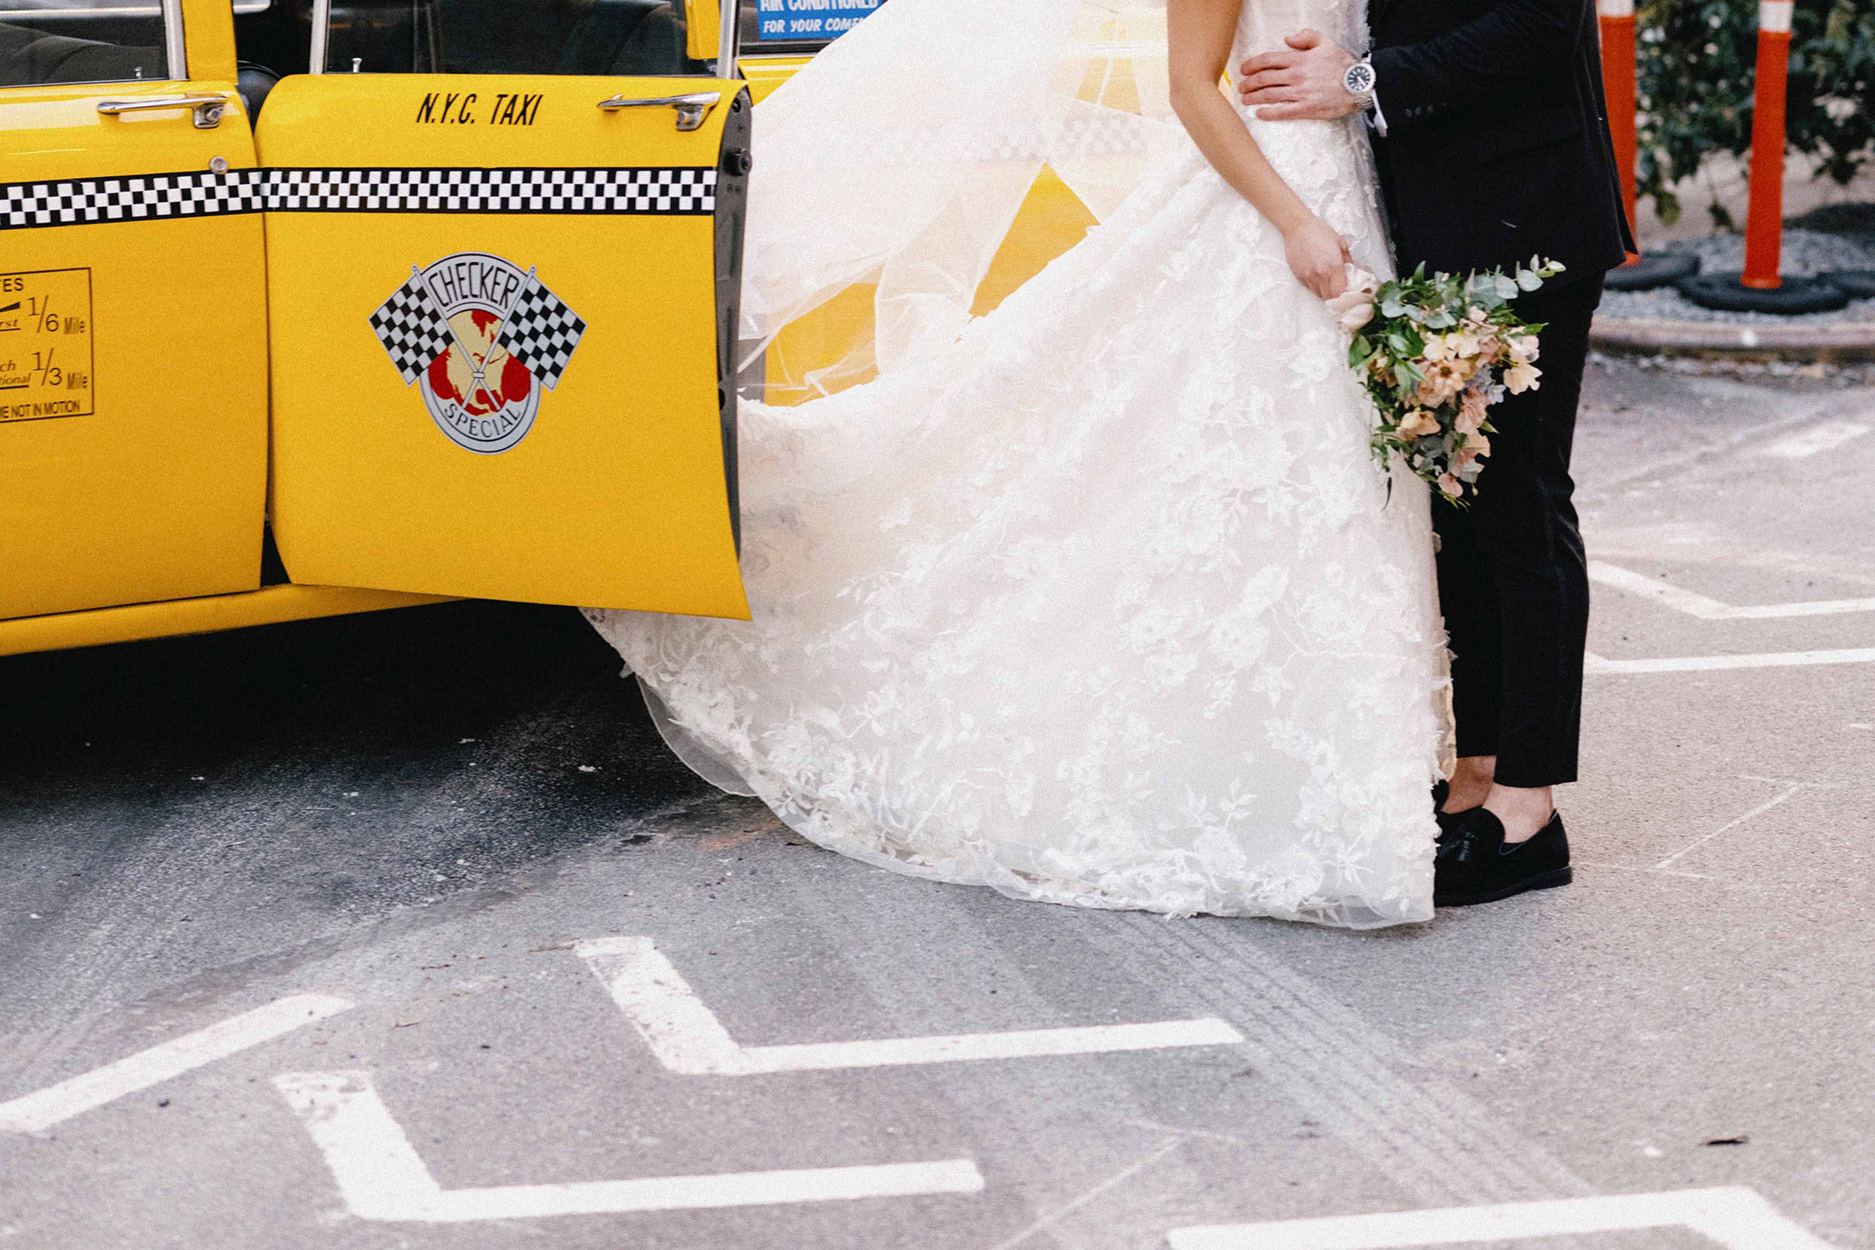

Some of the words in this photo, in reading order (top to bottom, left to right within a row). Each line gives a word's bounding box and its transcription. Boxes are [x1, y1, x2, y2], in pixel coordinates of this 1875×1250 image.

[763, 19, 786, 34] FOR
[790, 17, 822, 33] YOUR
[825, 17, 865, 31] COMF
[416, 92, 478, 125] N.Y.C.
[490, 93, 544, 126] TAXI
[0, 277, 24, 293] ES
[428, 261, 520, 311] CHECKER
[11, 403, 31, 419] NOT
[33, 402, 42, 417] IN
[44, 399, 80, 415] MOTION
[444, 402, 522, 439] SPECIAL
